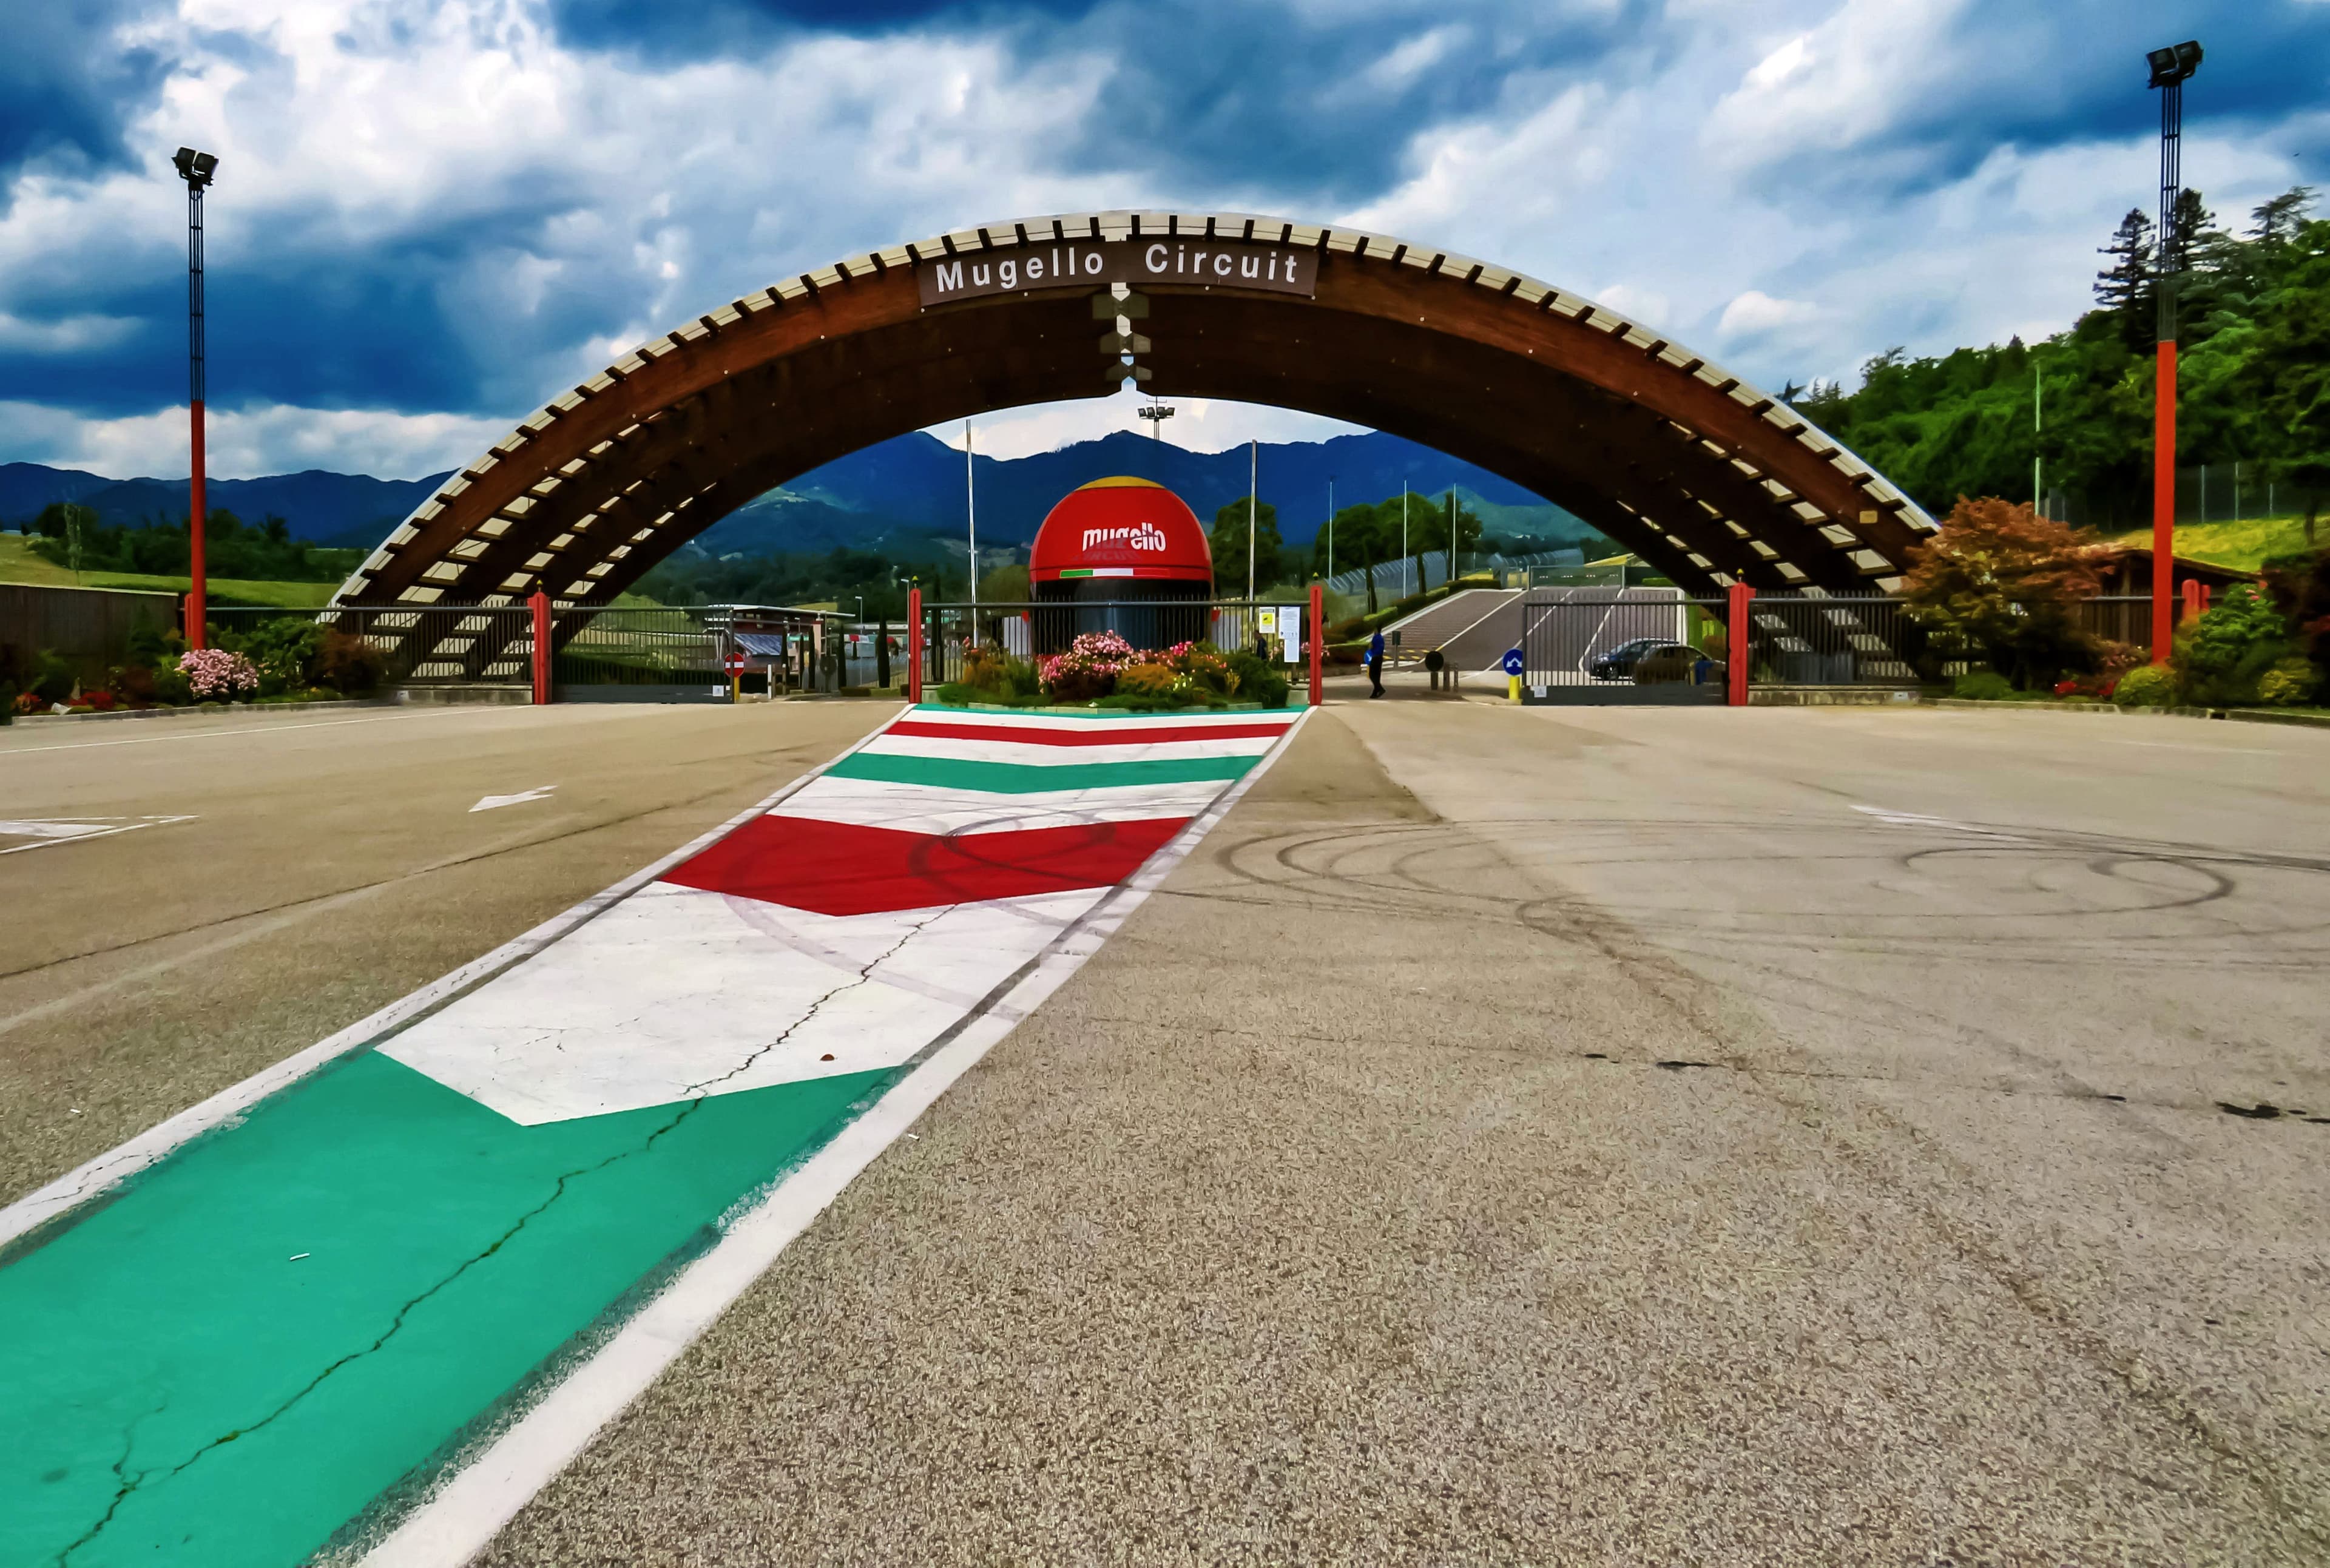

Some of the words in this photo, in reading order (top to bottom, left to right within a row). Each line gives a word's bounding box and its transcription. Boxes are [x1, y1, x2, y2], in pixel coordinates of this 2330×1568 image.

[936, 248, 1104, 292] Mugello
[1146, 244, 1297, 283] Circuit
[1082, 522, 1166, 552] mugello
